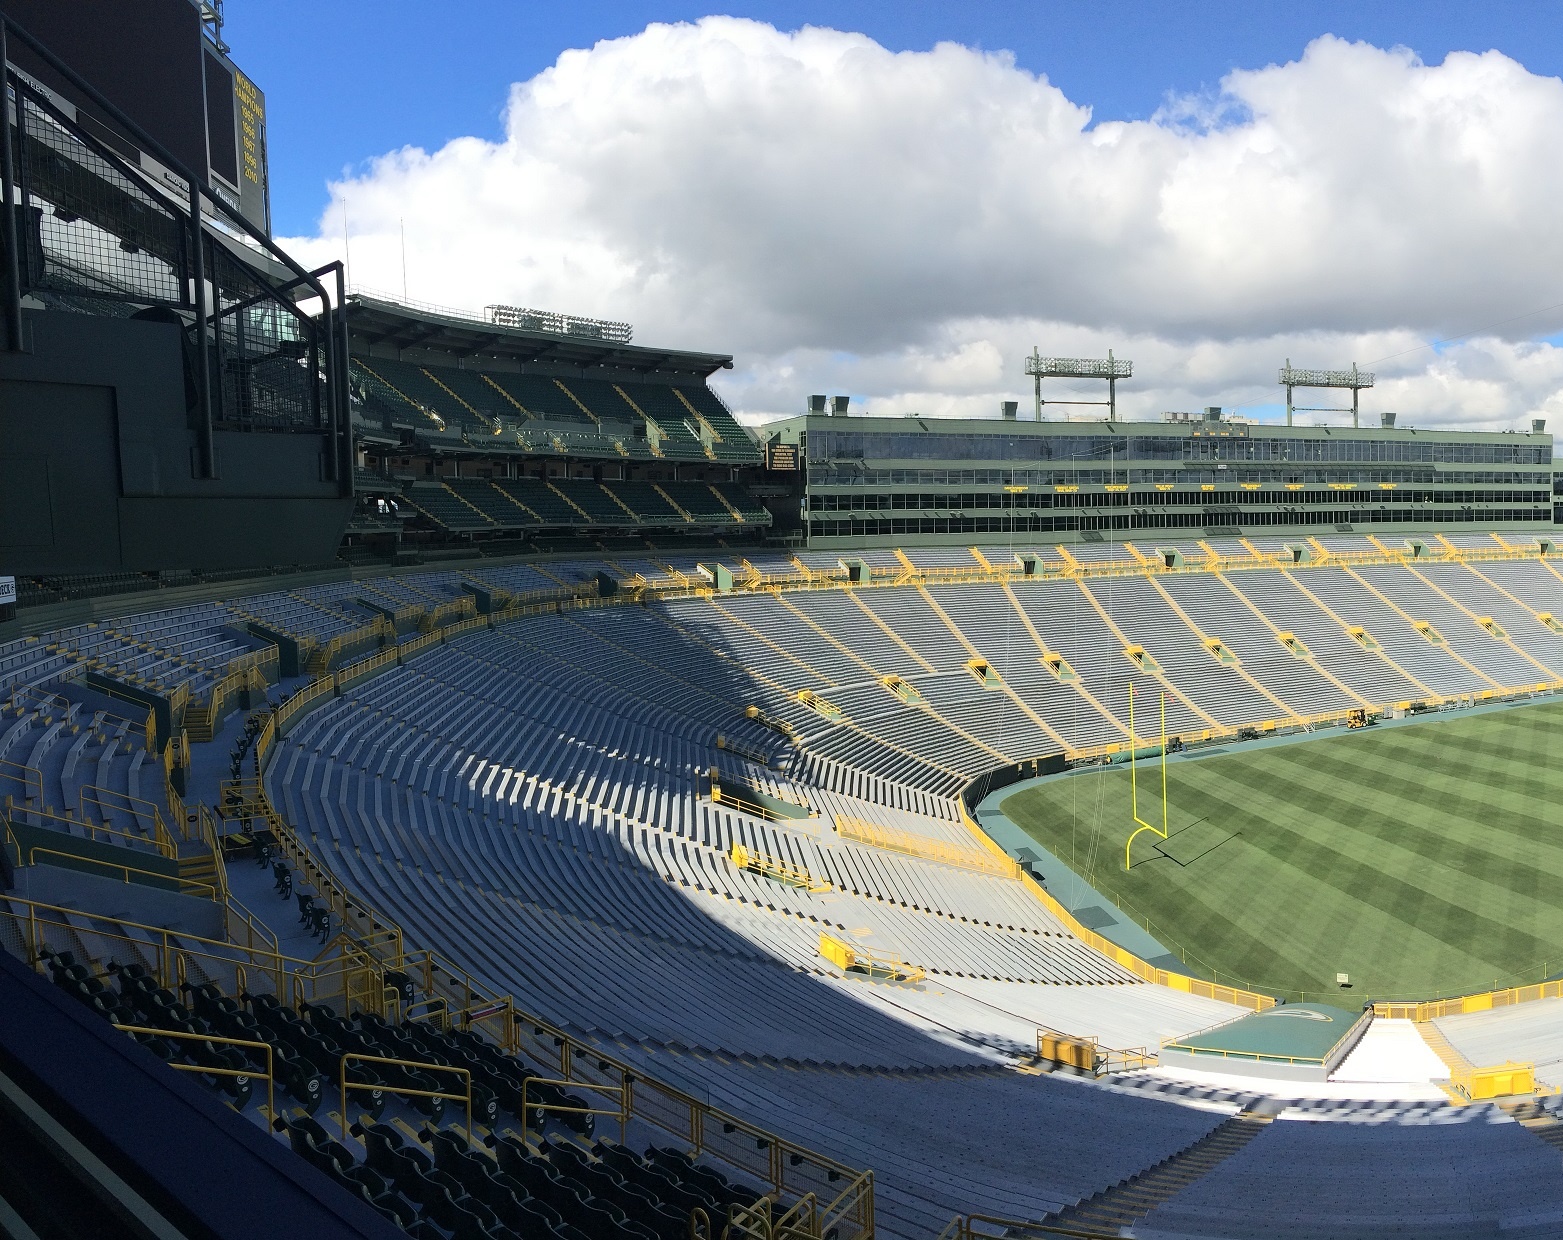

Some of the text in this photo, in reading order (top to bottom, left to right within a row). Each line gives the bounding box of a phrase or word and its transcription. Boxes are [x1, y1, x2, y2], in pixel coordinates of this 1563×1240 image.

[235, 71, 256, 99] WORLD
[235, 85, 263, 119] HAMPIONS
[243, 135, 256, 153] 1967
[244, 150, 257, 168] 1996
[244, 165, 258, 184] 2010
[0, 583, 10, 595] ECK
